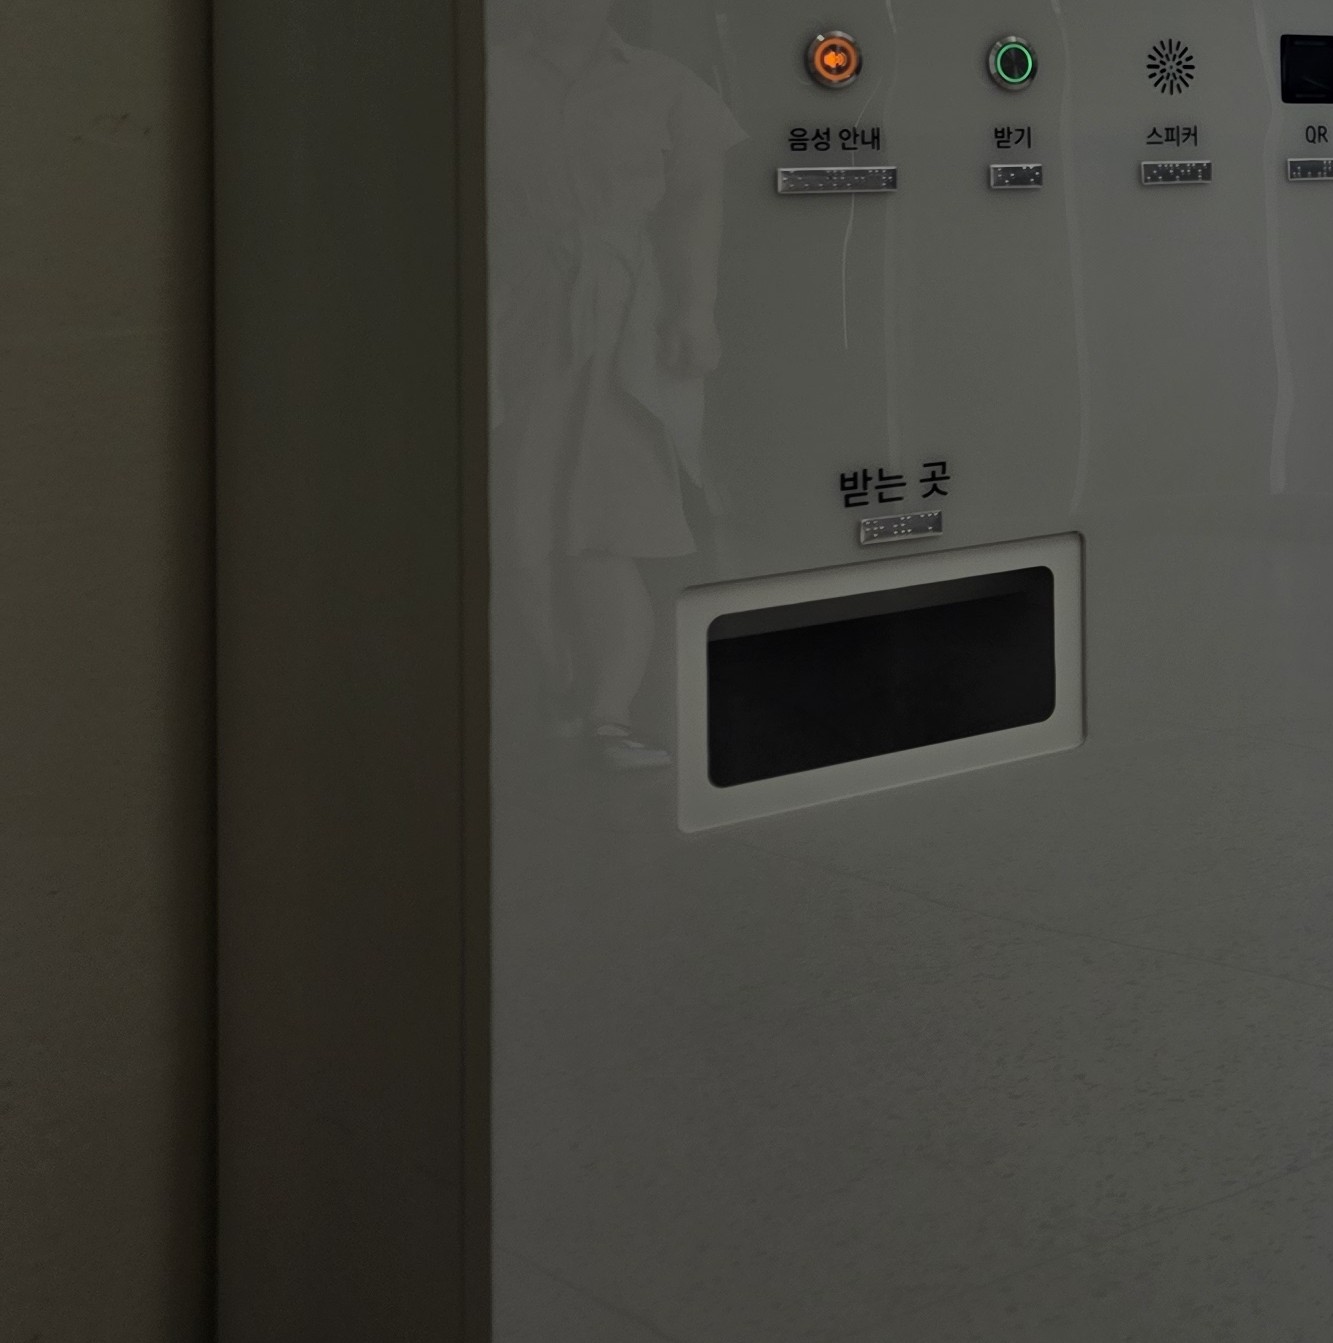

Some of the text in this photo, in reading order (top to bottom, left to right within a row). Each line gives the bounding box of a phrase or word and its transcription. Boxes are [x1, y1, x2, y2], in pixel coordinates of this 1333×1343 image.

[788, 127, 880, 152] 음성 안내
[994, 126, 1033, 149] 받기
[1146, 125, 1198, 147] 스피커
[1305, 125, 1328, 144] QR
[840, 461, 951, 508] 받는 곳
